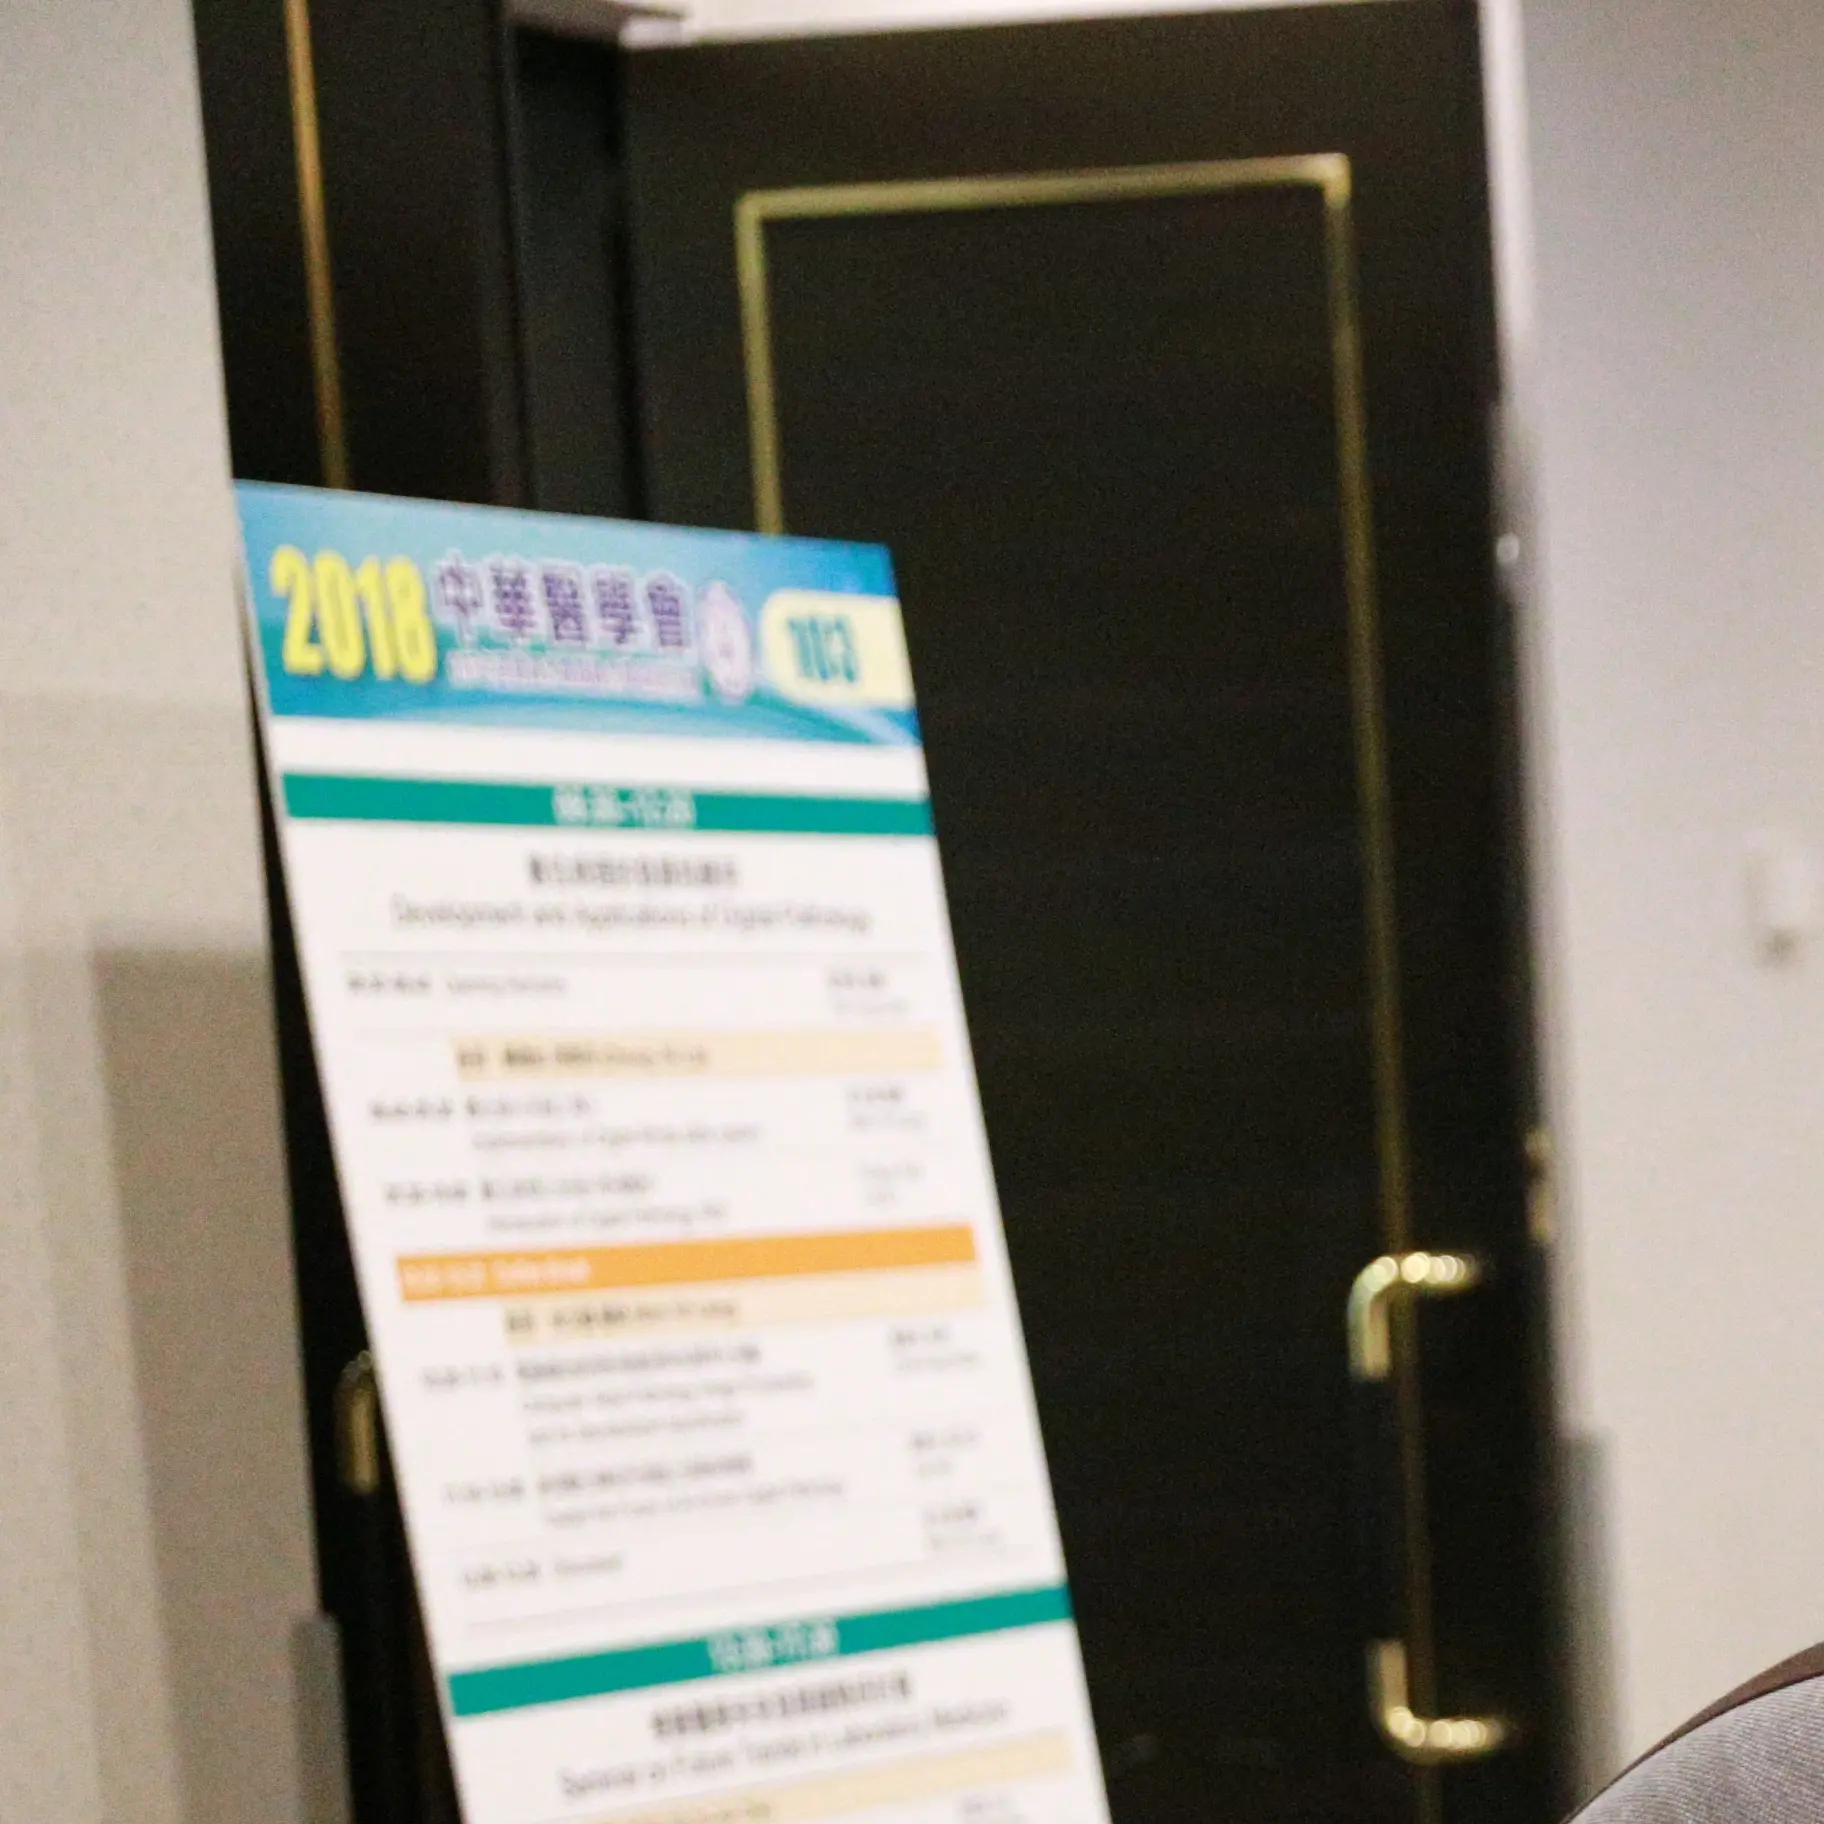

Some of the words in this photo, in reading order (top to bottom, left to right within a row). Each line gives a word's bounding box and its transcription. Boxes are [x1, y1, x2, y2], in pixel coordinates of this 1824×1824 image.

[269, 545, 438, 684] 2018
[438, 553, 690, 650] 中華醫學會
